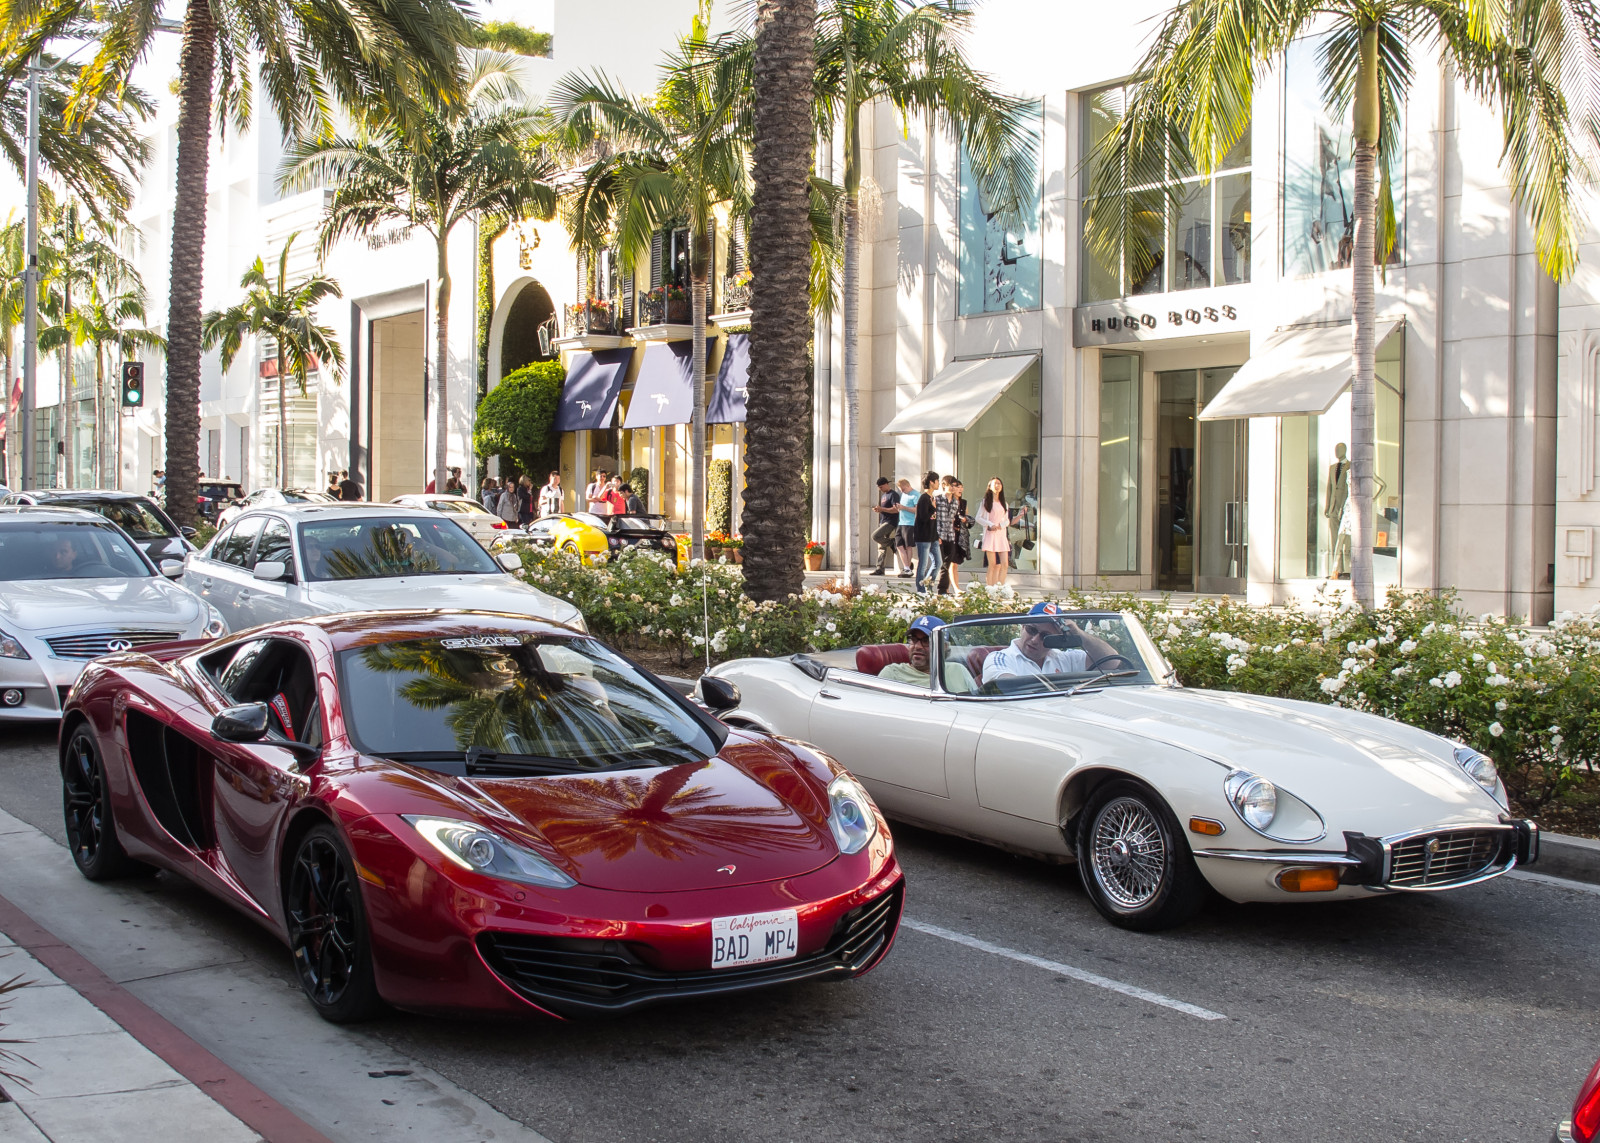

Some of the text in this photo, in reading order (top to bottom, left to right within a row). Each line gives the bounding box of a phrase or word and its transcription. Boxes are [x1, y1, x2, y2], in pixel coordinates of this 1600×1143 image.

[1091, 305, 1236, 331] HUGO BOSS
[729, 915, 784, 932] California
[713, 928, 795, 962] BAD MP4
[732, 955, 779, 965] dmv.ca.gov
